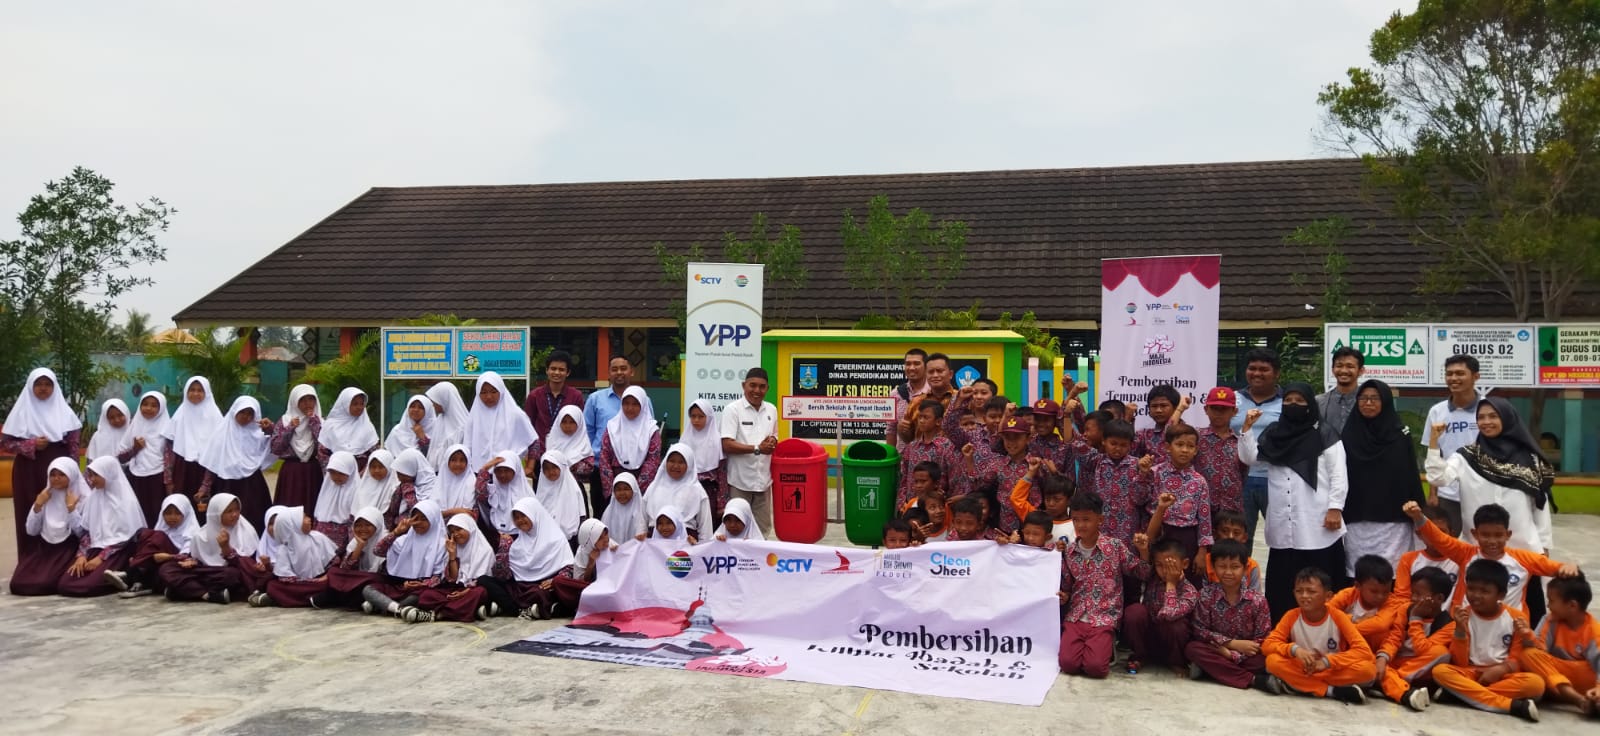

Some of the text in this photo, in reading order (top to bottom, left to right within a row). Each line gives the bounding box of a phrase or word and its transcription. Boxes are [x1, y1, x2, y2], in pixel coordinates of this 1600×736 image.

[700, 277, 721, 285] SCTV
[699, 324, 751, 347] YPP
[1351, 341, 1404, 357] UKS
[1452, 344, 1514, 355] GUGUS 02
[1560, 345, 1589, 353] GUGUS
[1118, 376, 1197, 389] Pembersihan
[698, 392, 743, 400] KITA SEMU
[826, 384, 844, 398] UPT
[846, 384, 858, 398] SD
[1445, 421, 1469, 433] YPP
[702, 556, 737, 574] YPP
[776, 559, 813, 573] SCTV
[930, 552, 971, 567] Clean
[859, 624, 1033, 656] Pembersihan
[913, 663, 1025, 680] Sekolah
